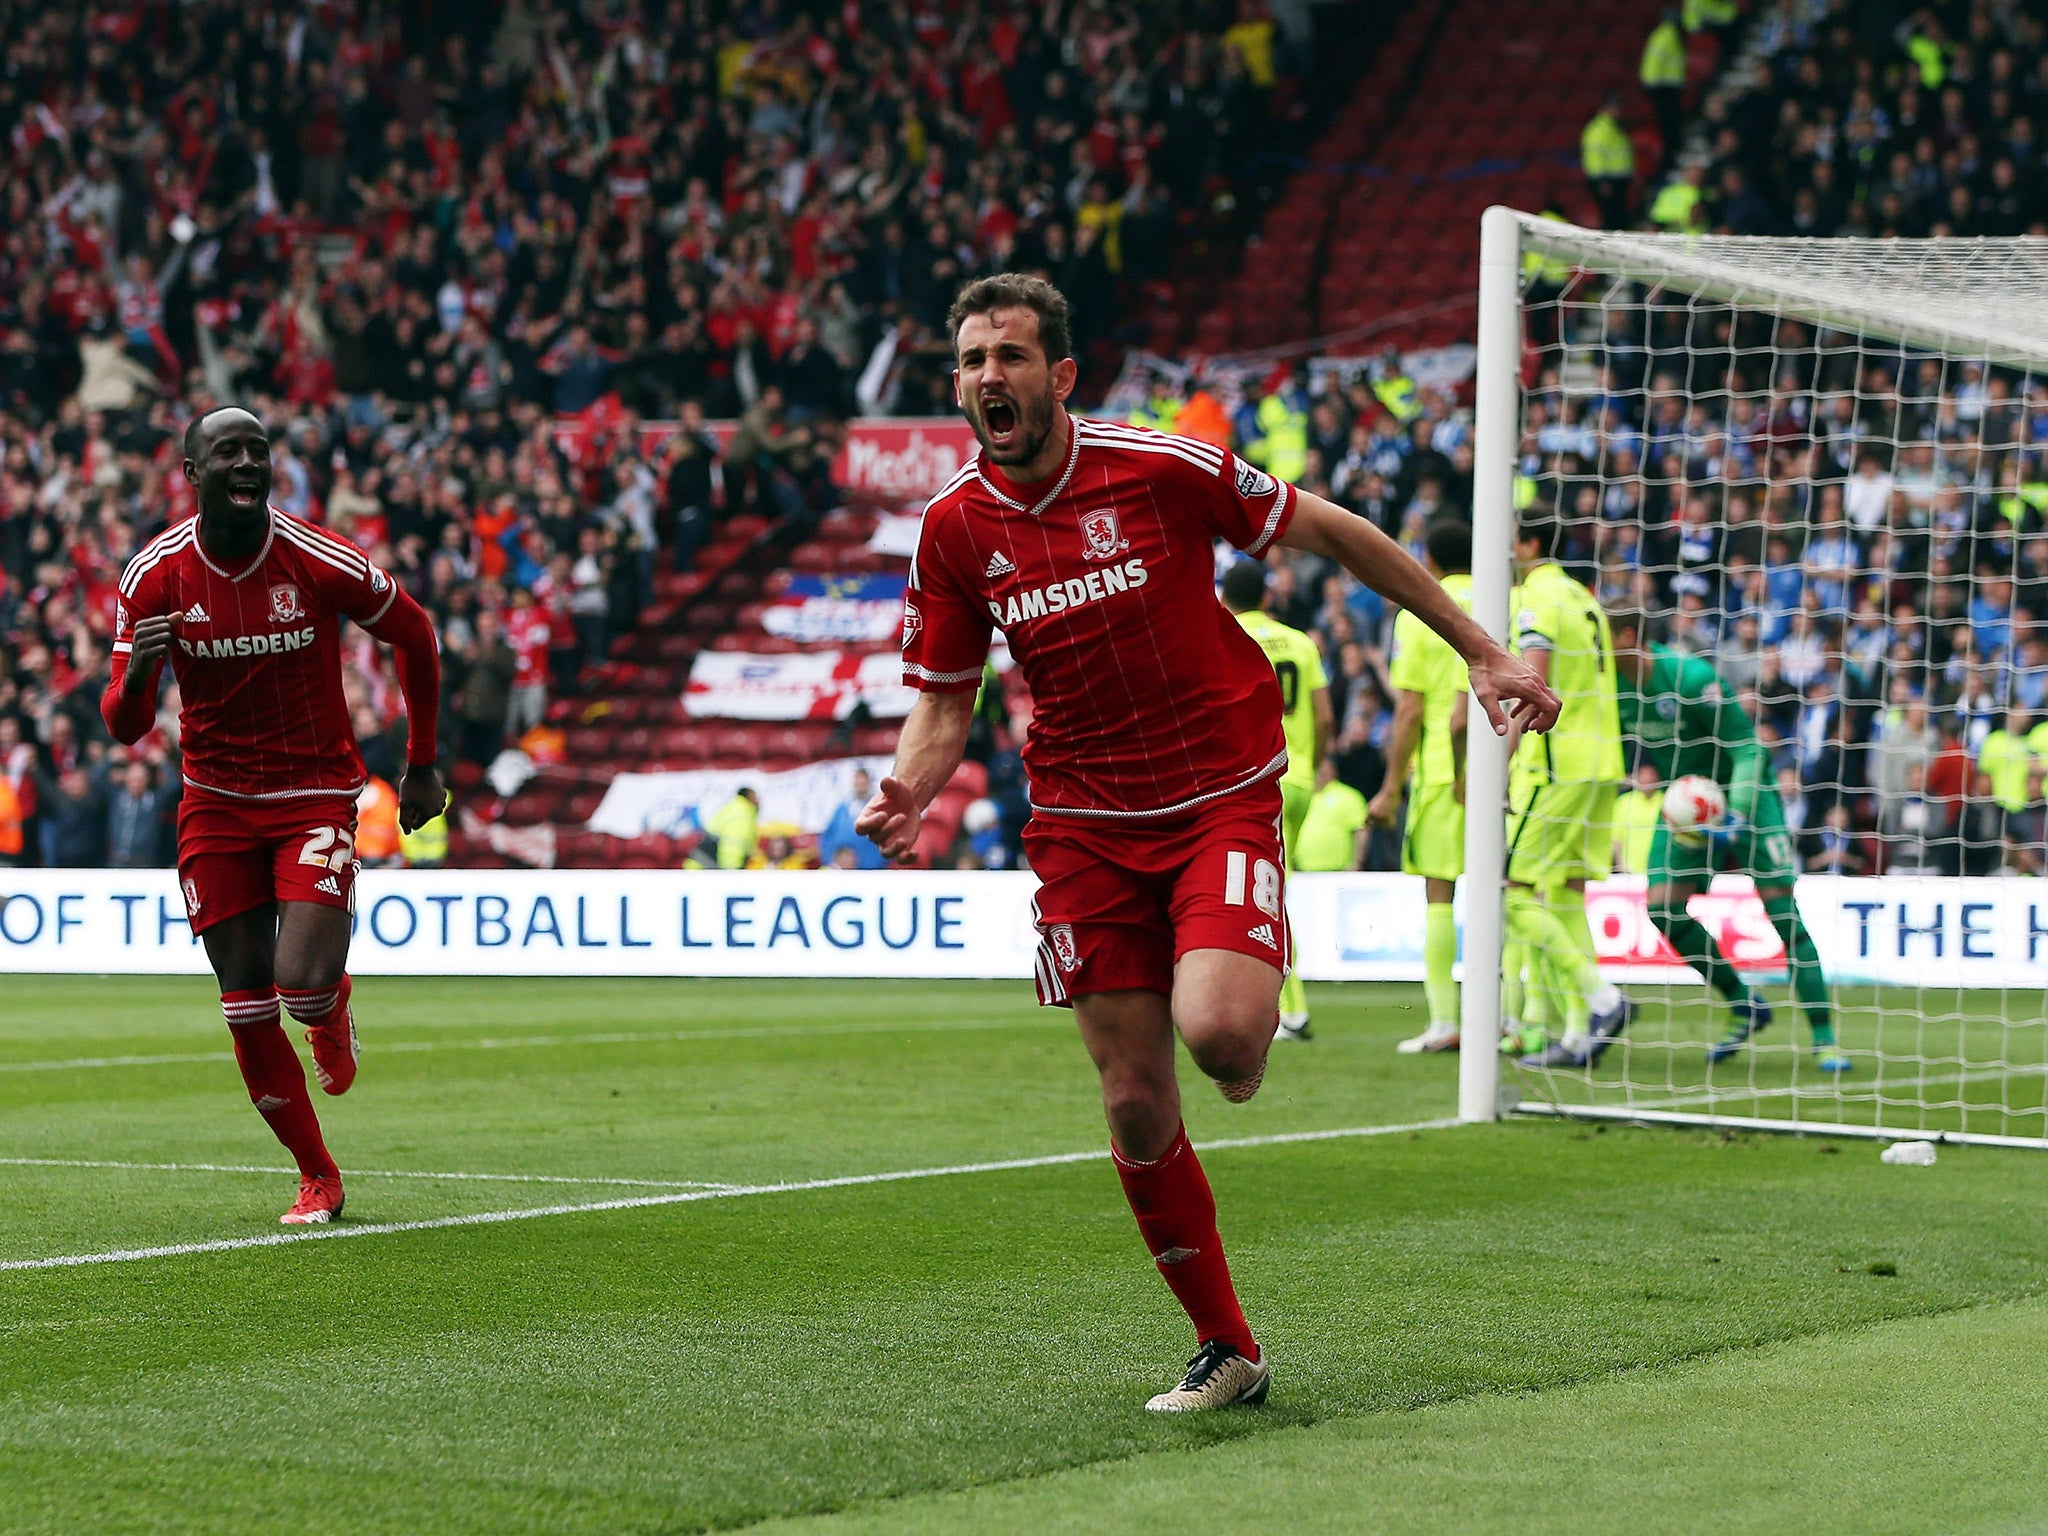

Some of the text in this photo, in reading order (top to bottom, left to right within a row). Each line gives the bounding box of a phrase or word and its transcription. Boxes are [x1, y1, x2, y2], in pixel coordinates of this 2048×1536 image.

[986, 563, 1017, 577] adidas
[988, 559, 1148, 626] RAMSDENS
[179, 626, 315, 658] RAMSDENS
[904, 616, 919, 627] ET
[1275, 660, 1298, 715] 0
[298, 826, 354, 874] 22
[1225, 851, 1280, 922] 18
[0, 894, 965, 949] OF TH OTBALL LEAGUE
[1842, 904, 1994, 958] THE
